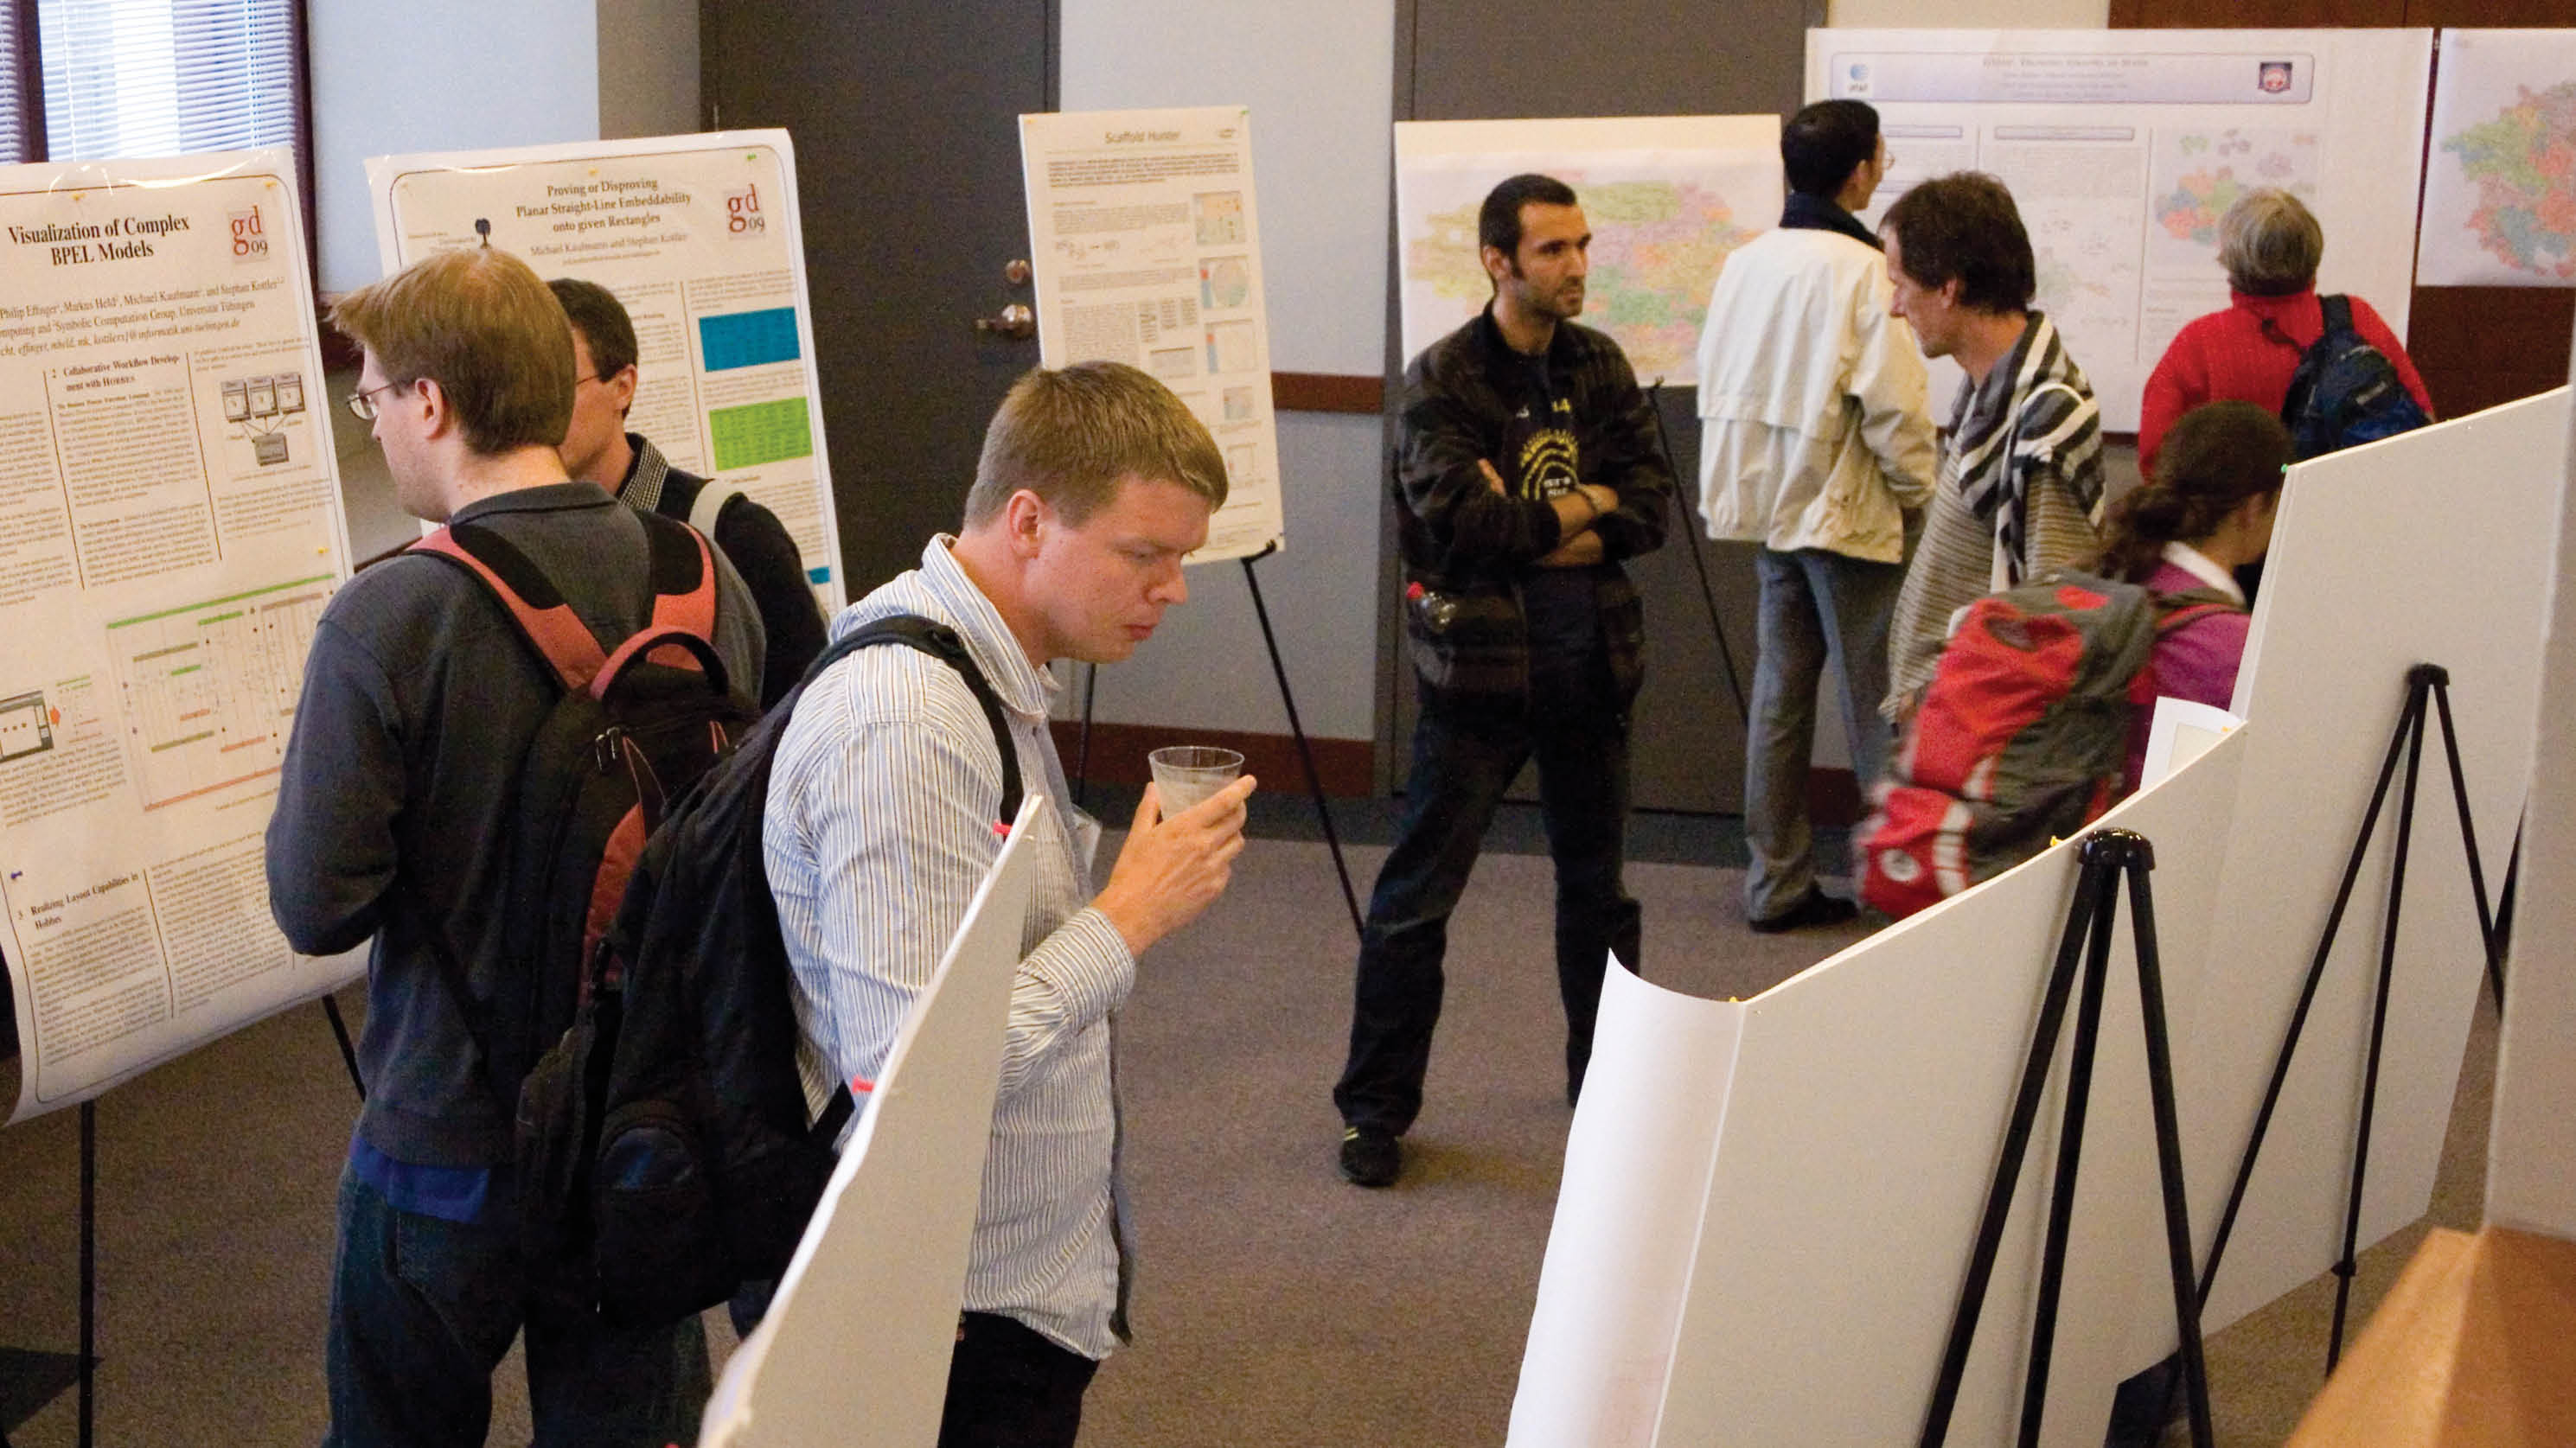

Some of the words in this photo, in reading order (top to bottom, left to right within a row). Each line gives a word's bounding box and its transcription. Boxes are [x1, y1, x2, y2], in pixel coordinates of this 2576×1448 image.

[1105, 131, 1145, 144] Scaffold
[1148, 131, 1181, 141] Hunter
[547, 184, 585, 197] Proving
[588, 184, 598, 194] or
[601, 178, 657, 194] Disproving
[516, 204, 549, 218] Planar
[551, 200, 617, 216] Straight-Line
[618, 192, 691, 208] Embeddability
[8, 221, 100, 244] Visualization
[105, 217, 120, 237] of
[124, 214, 189, 237] Complex
[553, 220, 575, 233] onto
[578, 218, 605, 233] given
[608, 214, 661, 227] Rectangles
[749, 216, 765, 233] 09
[51, 245, 95, 266] BPEL
[98, 239, 154, 262] Models
[251, 239, 268, 256] 09
[610, 238, 624, 248] and
[93, 312, 148, 328] Computation
[64, 361, 111, 377] Collaborative
[112, 357, 149, 370] Workflow
[86, 379, 101, 388] with
[31, 899, 64, 915] Realizing
[65, 889, 91, 903] Layout
